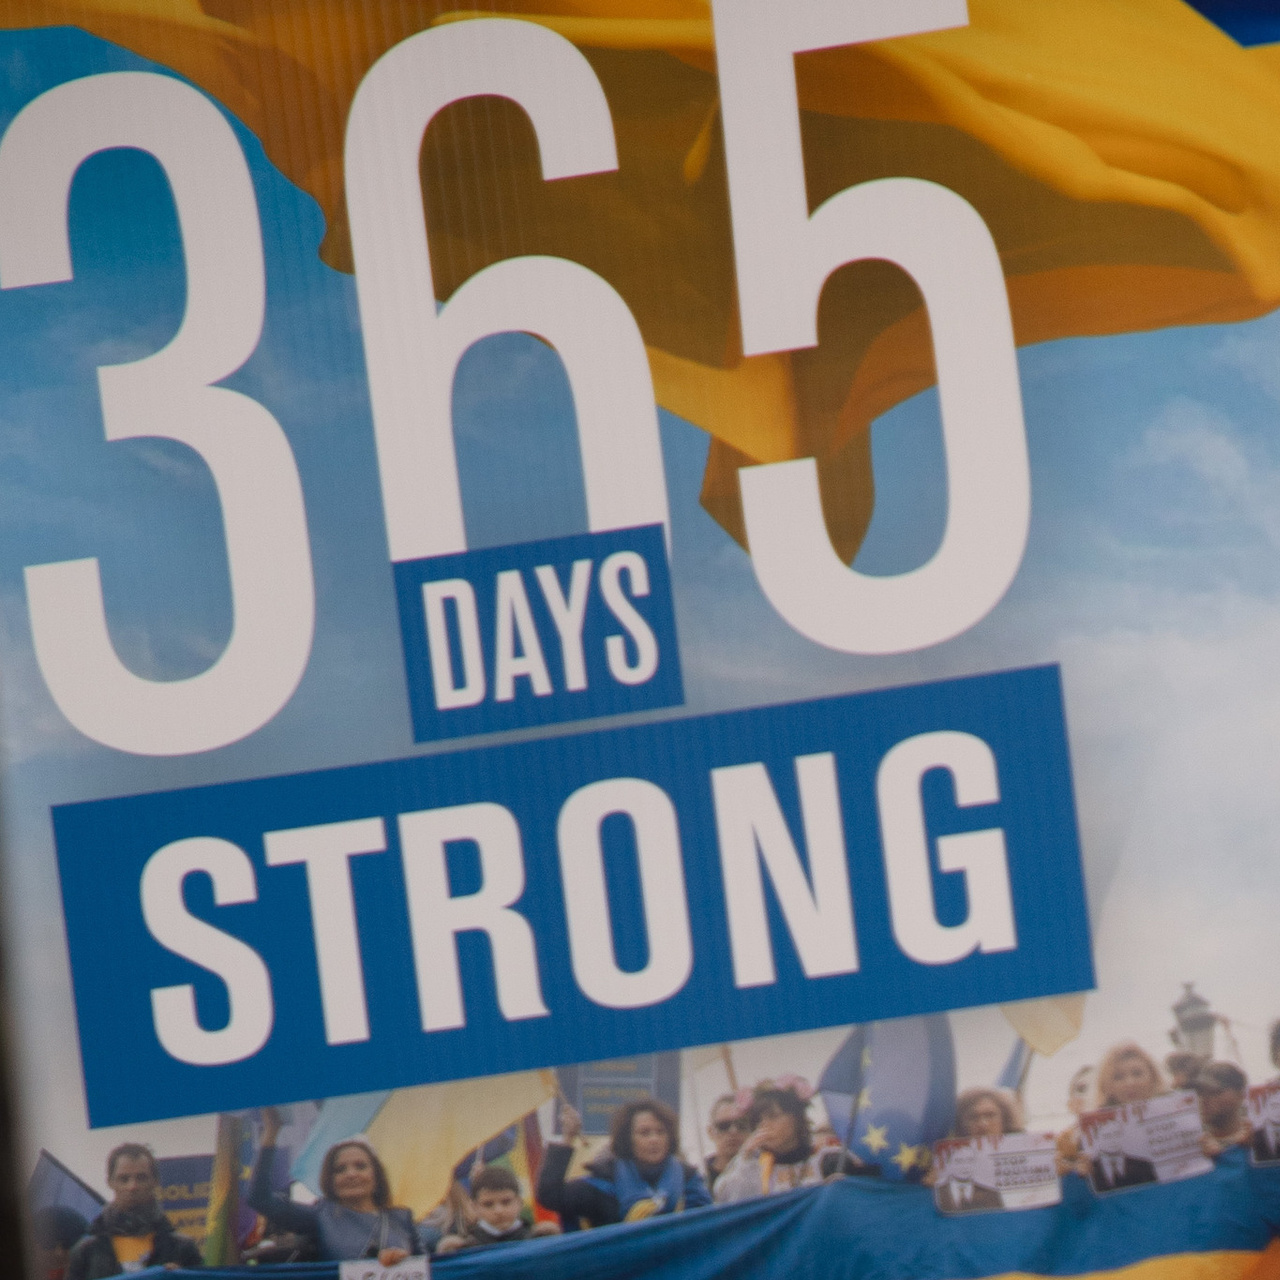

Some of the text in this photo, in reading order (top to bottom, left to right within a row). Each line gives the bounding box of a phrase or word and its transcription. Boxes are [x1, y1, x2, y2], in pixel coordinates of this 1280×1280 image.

[0, 0, 1030, 756] 365
[422, 550, 661, 711] DAYS
[139, 730, 1018, 1067] STRONG
